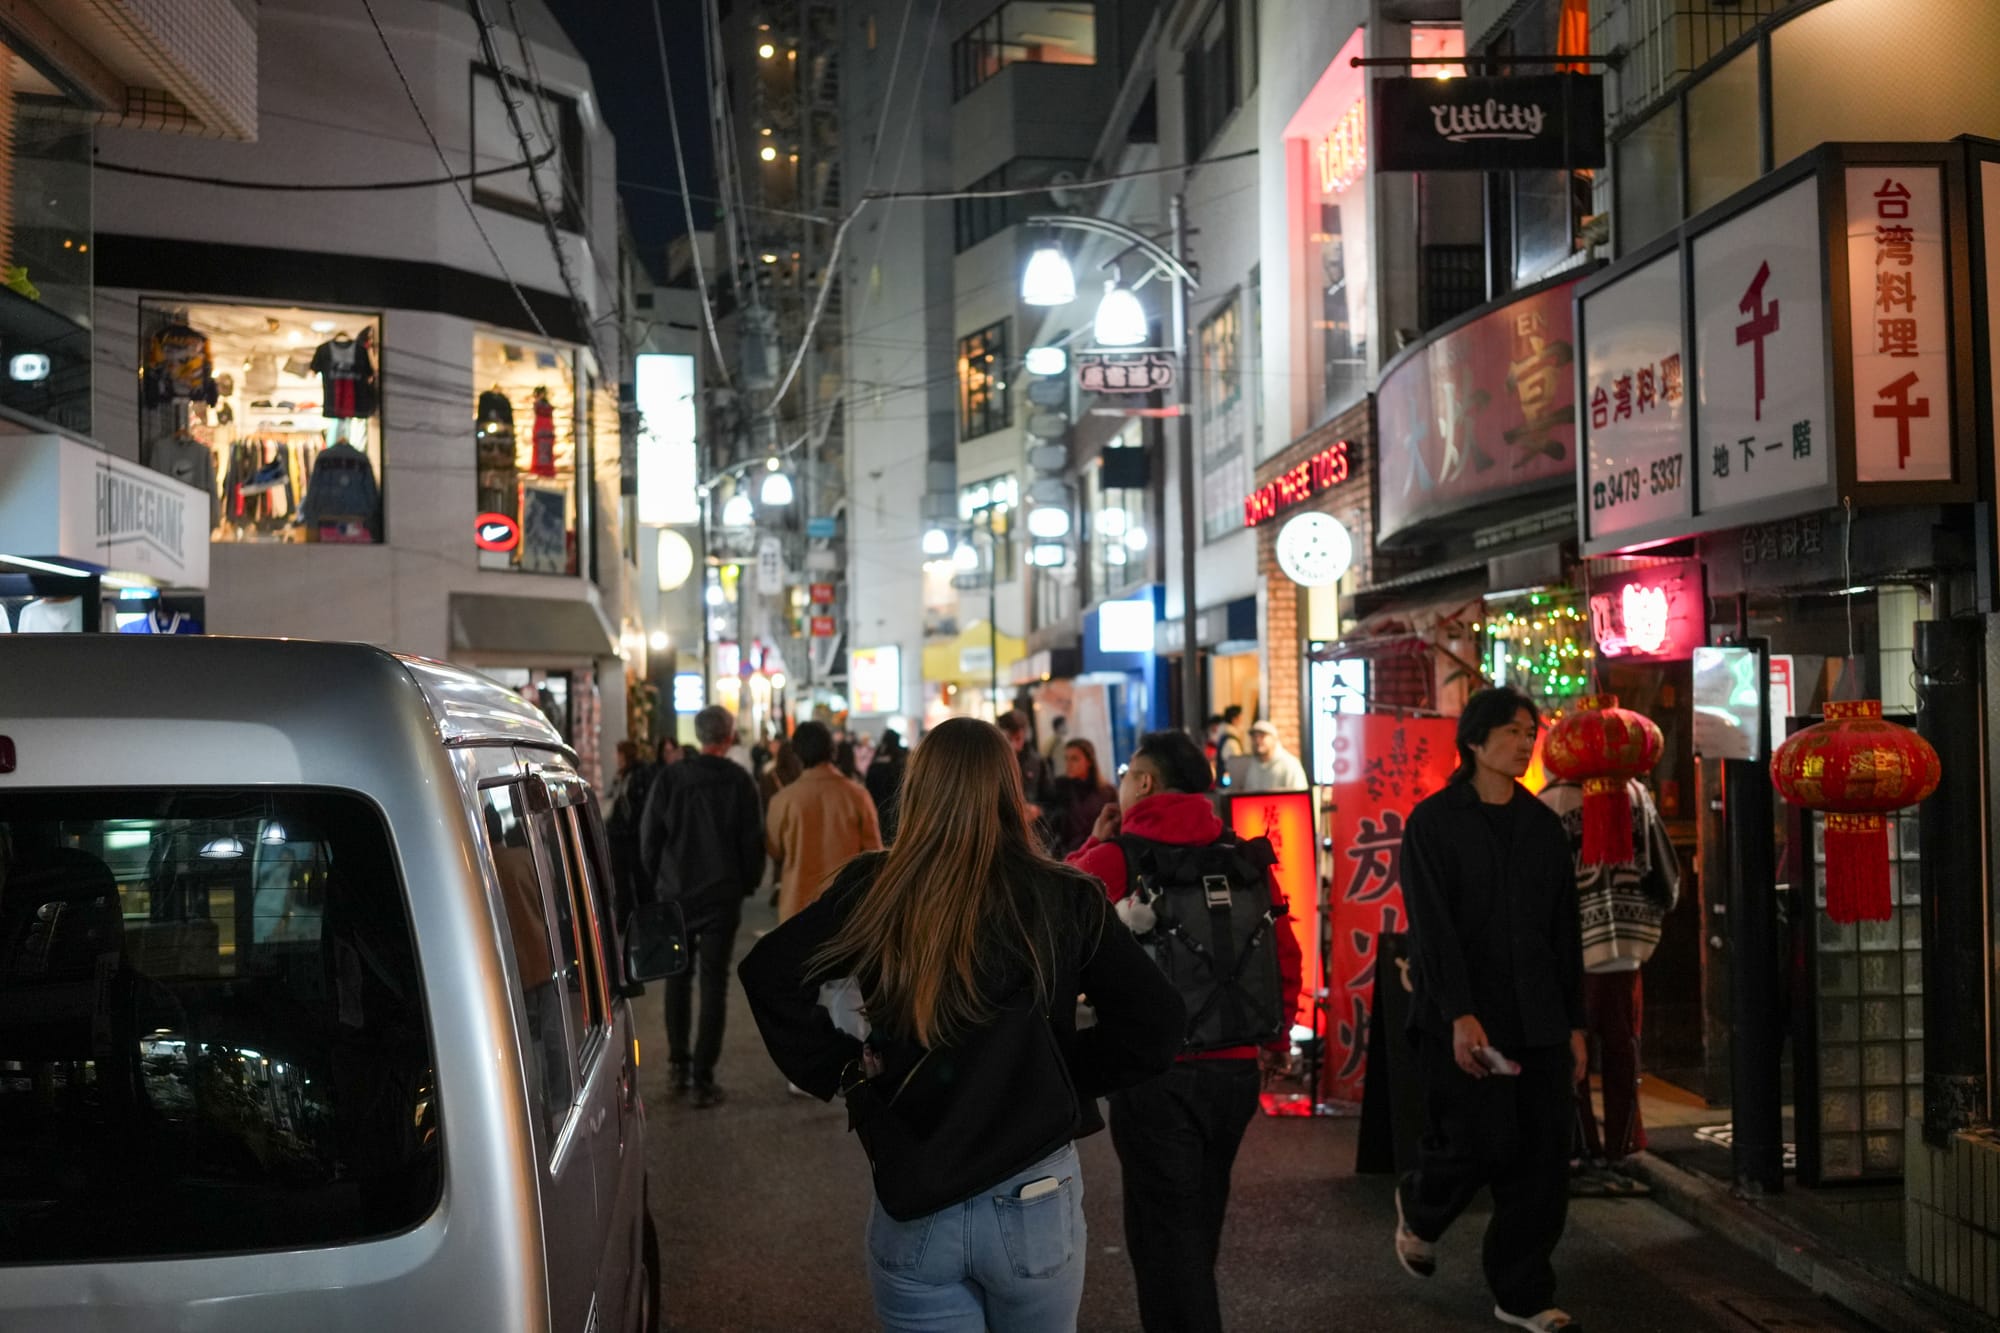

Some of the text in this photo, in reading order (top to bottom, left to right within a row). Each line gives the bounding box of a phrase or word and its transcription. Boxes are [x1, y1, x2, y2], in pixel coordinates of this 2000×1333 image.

[1429, 98, 1547, 135] Utility
[1873, 178, 1920, 358] 台湾料理
[1736, 260, 1780, 422] 千
[1591, 354, 1683, 429] 台湾料理
[1873, 371, 1930, 470] 千
[1712, 420, 1812, 478] 地下一階
[96, 471, 184, 559] HOMEGAME
